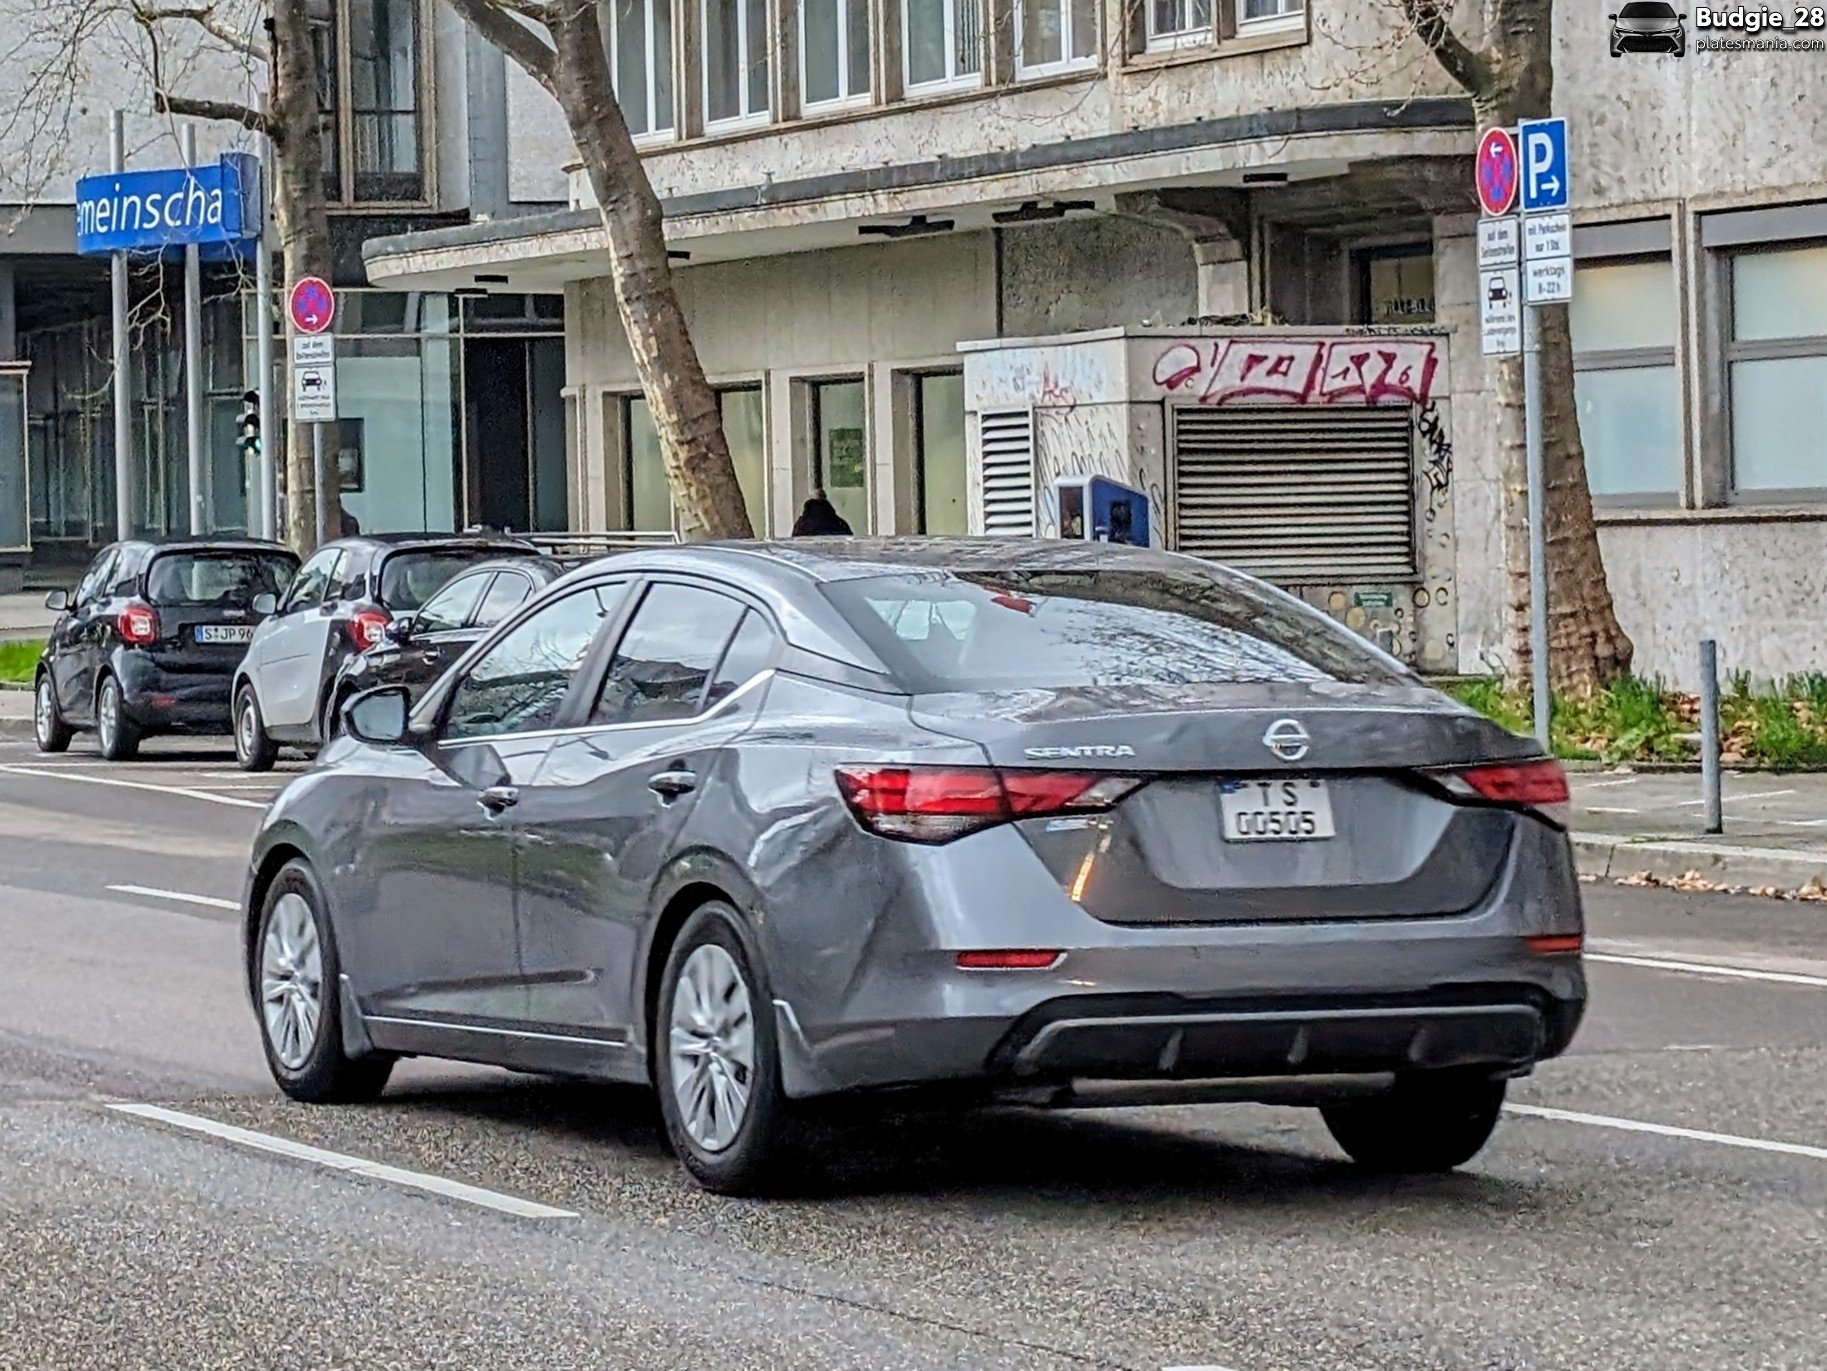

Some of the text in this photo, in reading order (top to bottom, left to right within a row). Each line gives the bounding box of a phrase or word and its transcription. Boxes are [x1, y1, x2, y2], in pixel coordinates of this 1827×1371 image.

[1528, 132, 1553, 199] P
[1533, 266, 1565, 278] werktags
[205, 628, 212, 639] S
[1024, 744, 1136, 759] SENTRA
[1236, 811, 1315, 835] 00505
